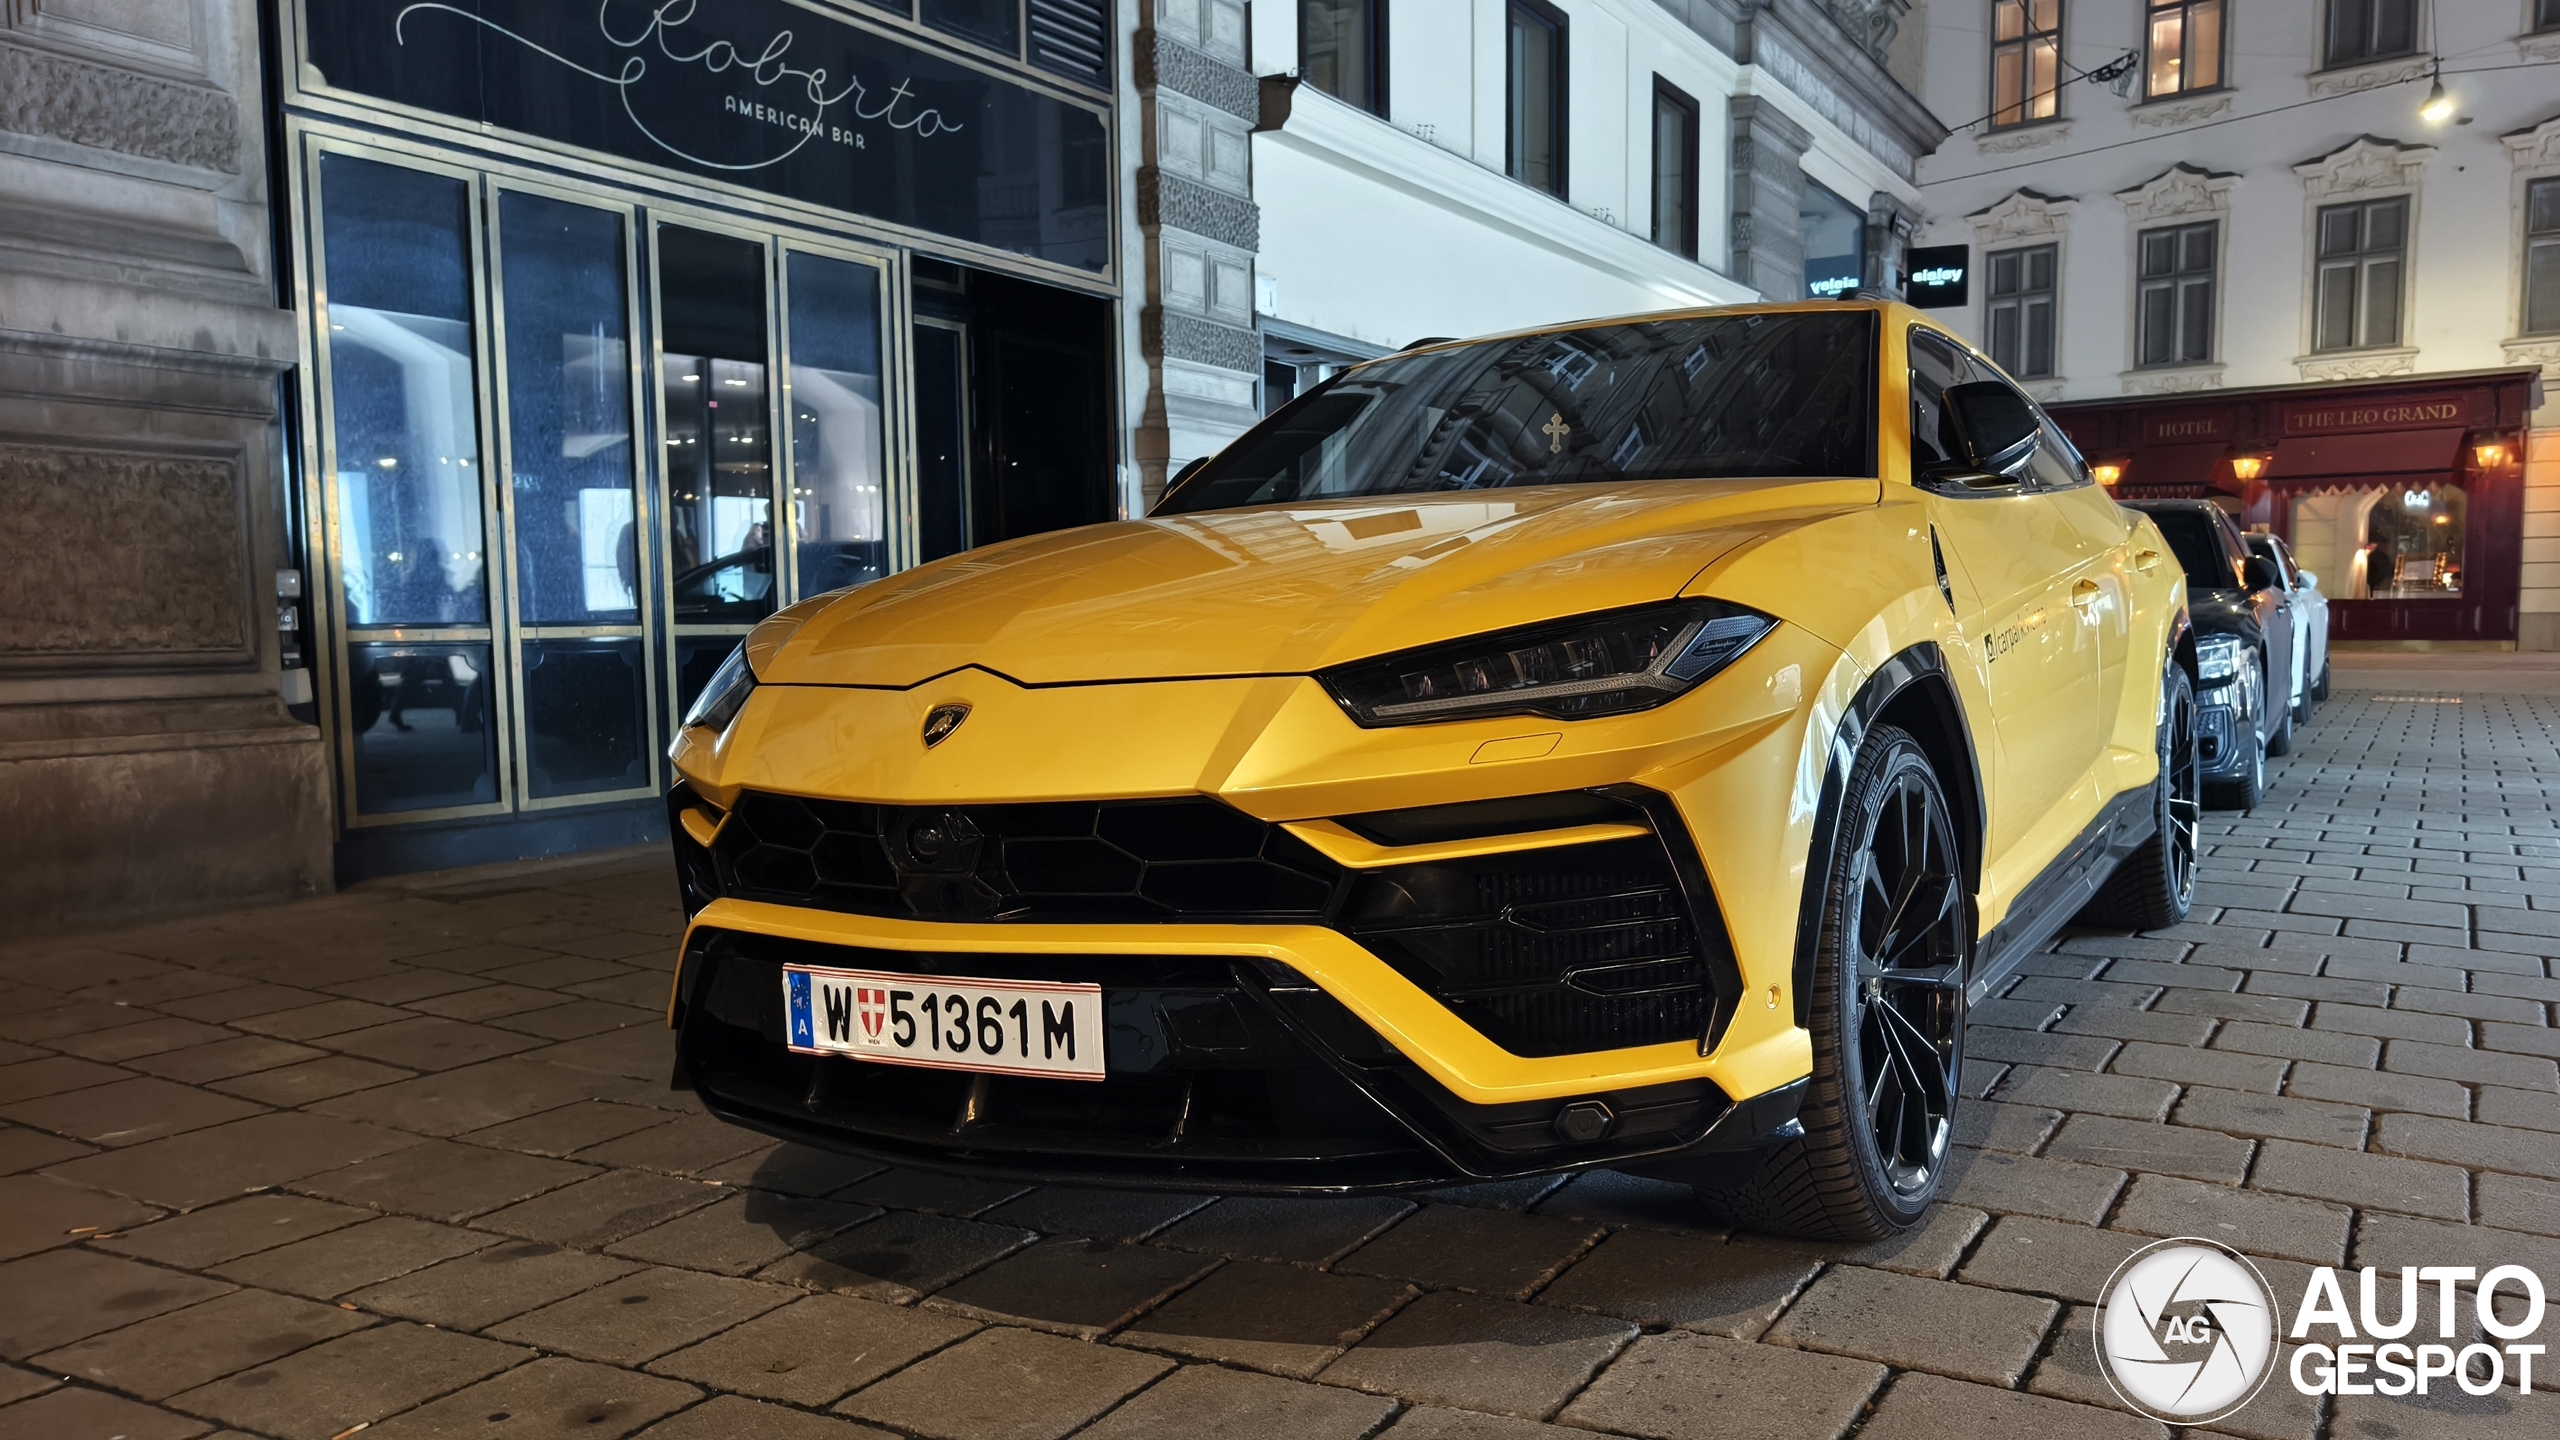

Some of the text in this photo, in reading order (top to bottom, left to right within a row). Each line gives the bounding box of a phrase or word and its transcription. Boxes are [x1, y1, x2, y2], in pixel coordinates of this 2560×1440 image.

[600, 0, 963, 138] Roberto
[725, 95, 866, 149] AMERICAN BAR
[2158, 420, 2216, 438] HOTEL
[2294, 403, 2457, 428] THE LEO GRAND
[798, 1018, 809, 1036] A
[823, 983, 852, 1043] W
